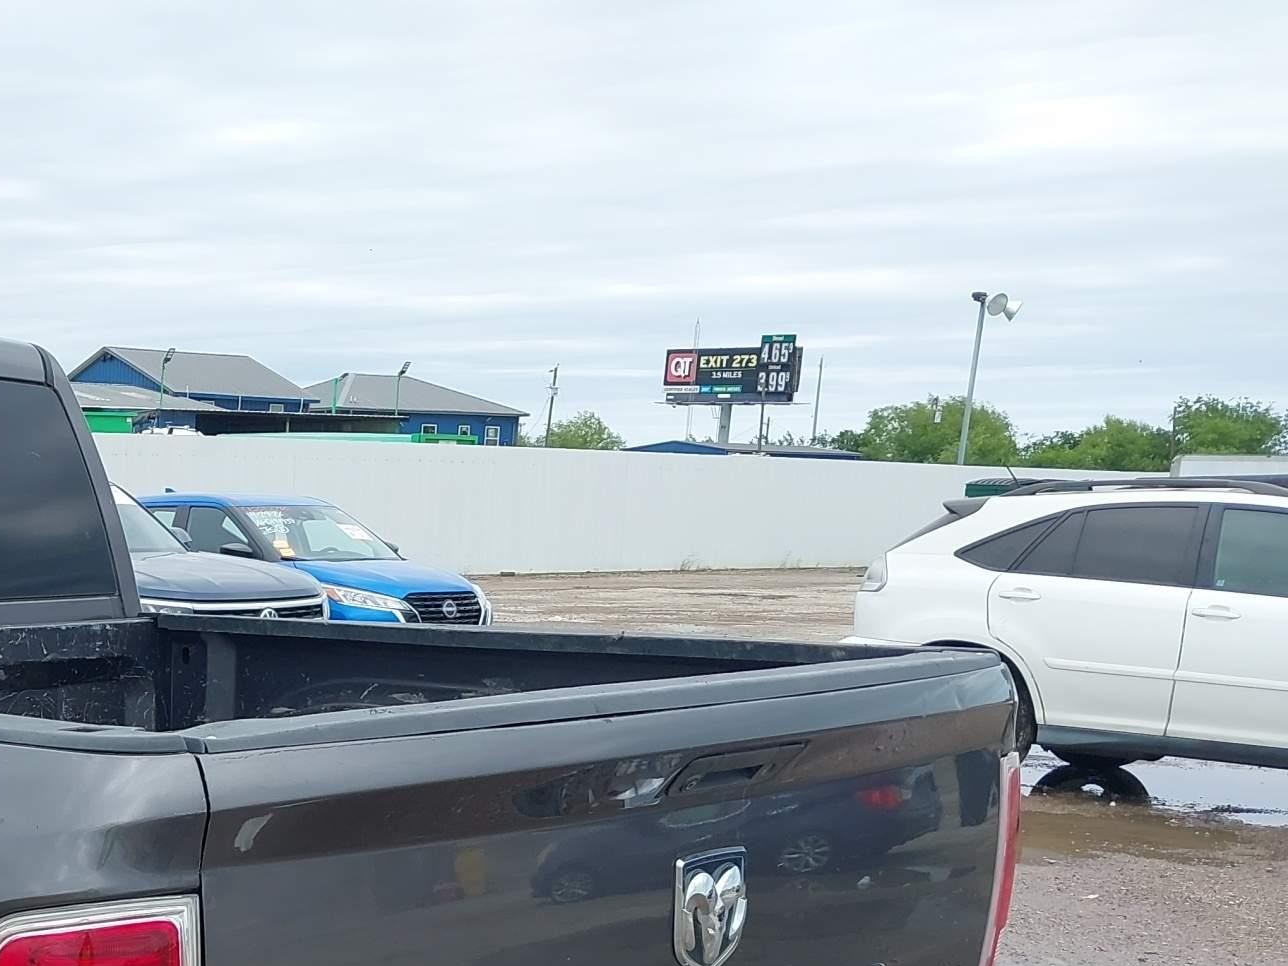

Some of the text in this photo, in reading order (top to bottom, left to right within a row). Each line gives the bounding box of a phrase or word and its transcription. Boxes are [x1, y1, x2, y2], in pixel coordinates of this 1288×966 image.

[671, 357, 693, 378] QT
[699, 354, 758, 368] EXIT 273
[722, 371, 743, 379] MILES
